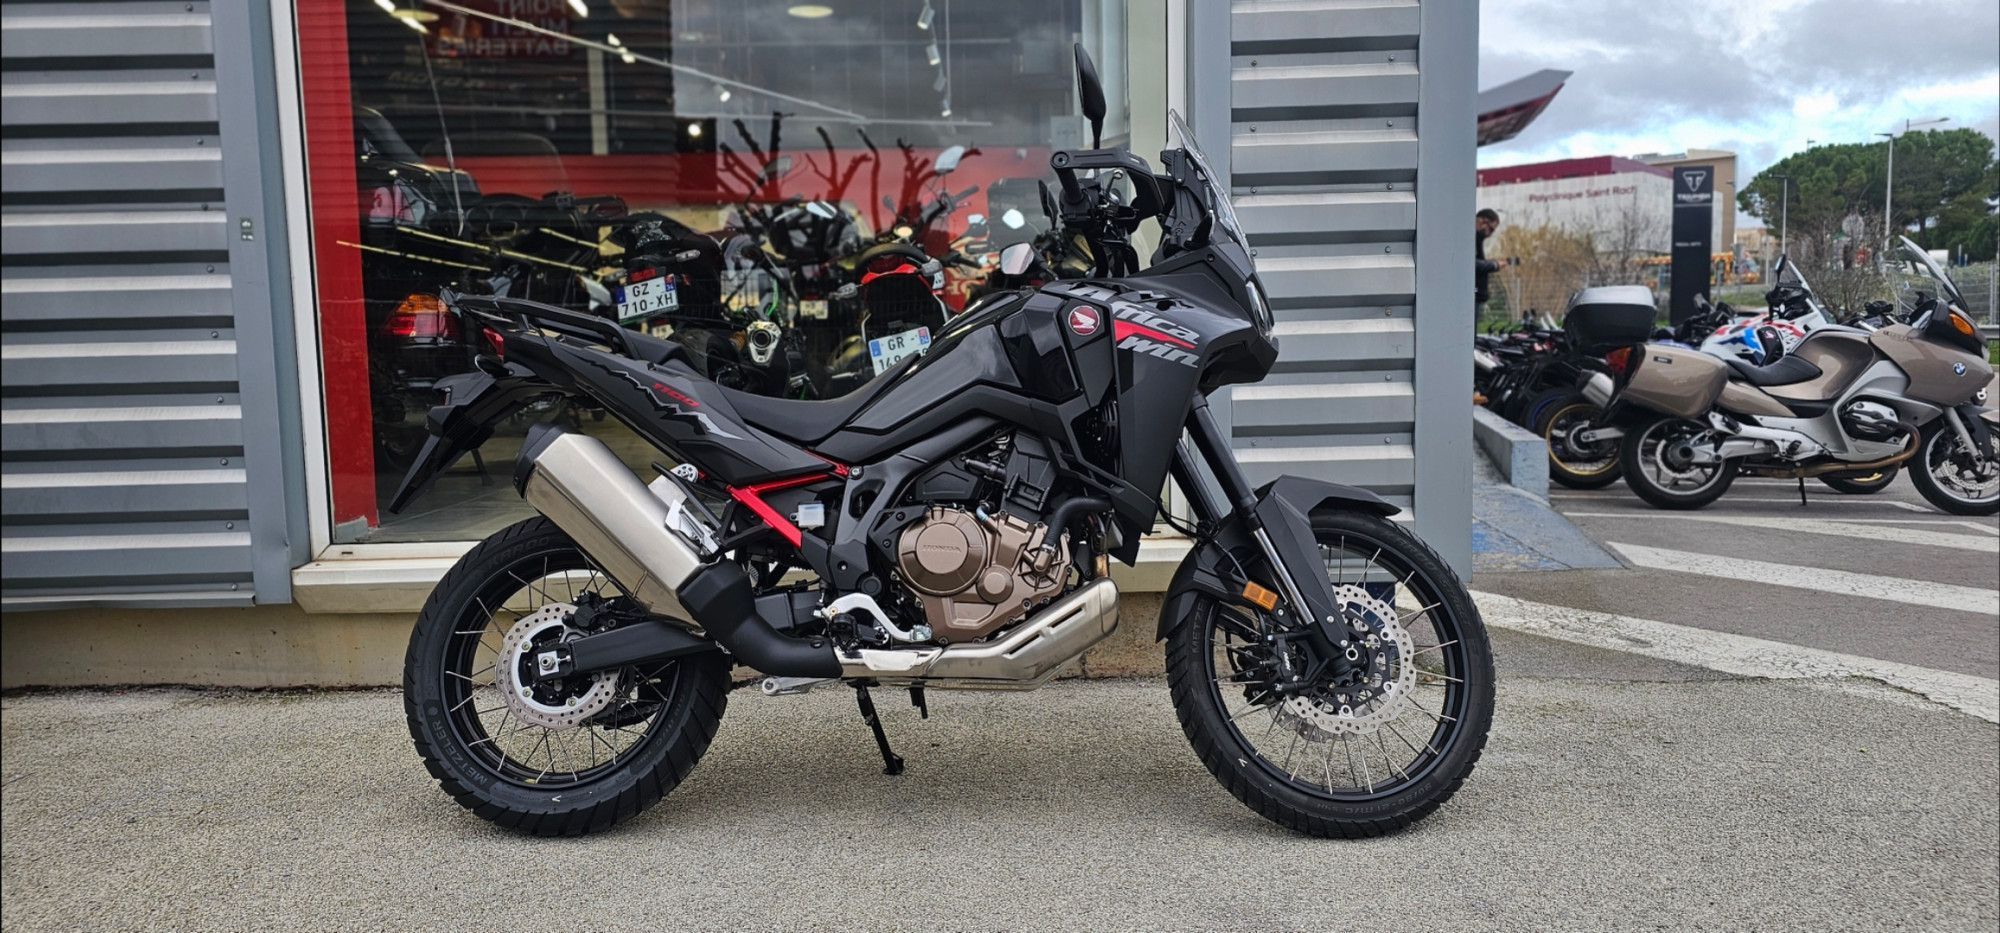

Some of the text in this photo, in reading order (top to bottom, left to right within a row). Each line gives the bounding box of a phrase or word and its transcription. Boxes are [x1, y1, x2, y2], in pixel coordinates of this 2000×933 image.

[1585, 187, 1610, 198] Saint
[621, 292, 674, 316] 710-XH
[653, 382, 700, 407] 1100
[922, 543, 962, 553] HONDA
[431, 719, 489, 785] METZELER
